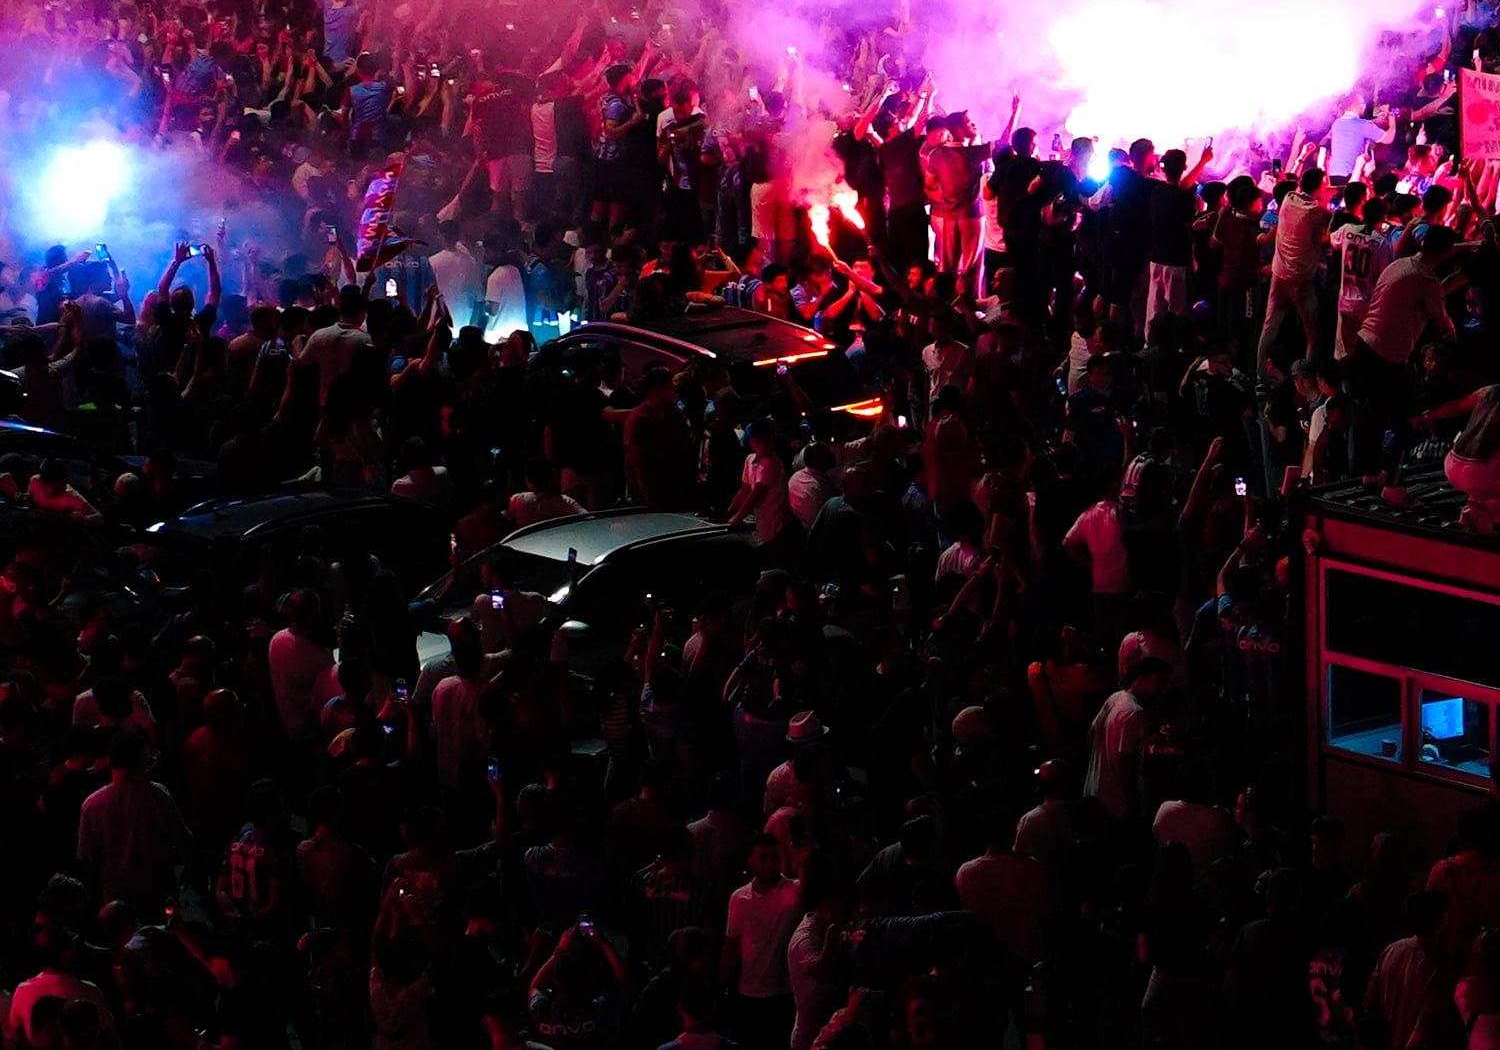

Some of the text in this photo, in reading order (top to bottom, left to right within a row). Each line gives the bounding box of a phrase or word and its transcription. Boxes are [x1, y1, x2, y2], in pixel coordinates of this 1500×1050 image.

[478, 88, 513, 103] onvo
[1345, 231, 1387, 248] onvo
[1239, 639, 1281, 654] onvo
[230, 841, 266, 857] onvo
[230, 854, 258, 901] 61
[538, 1019, 598, 1038] onvo
